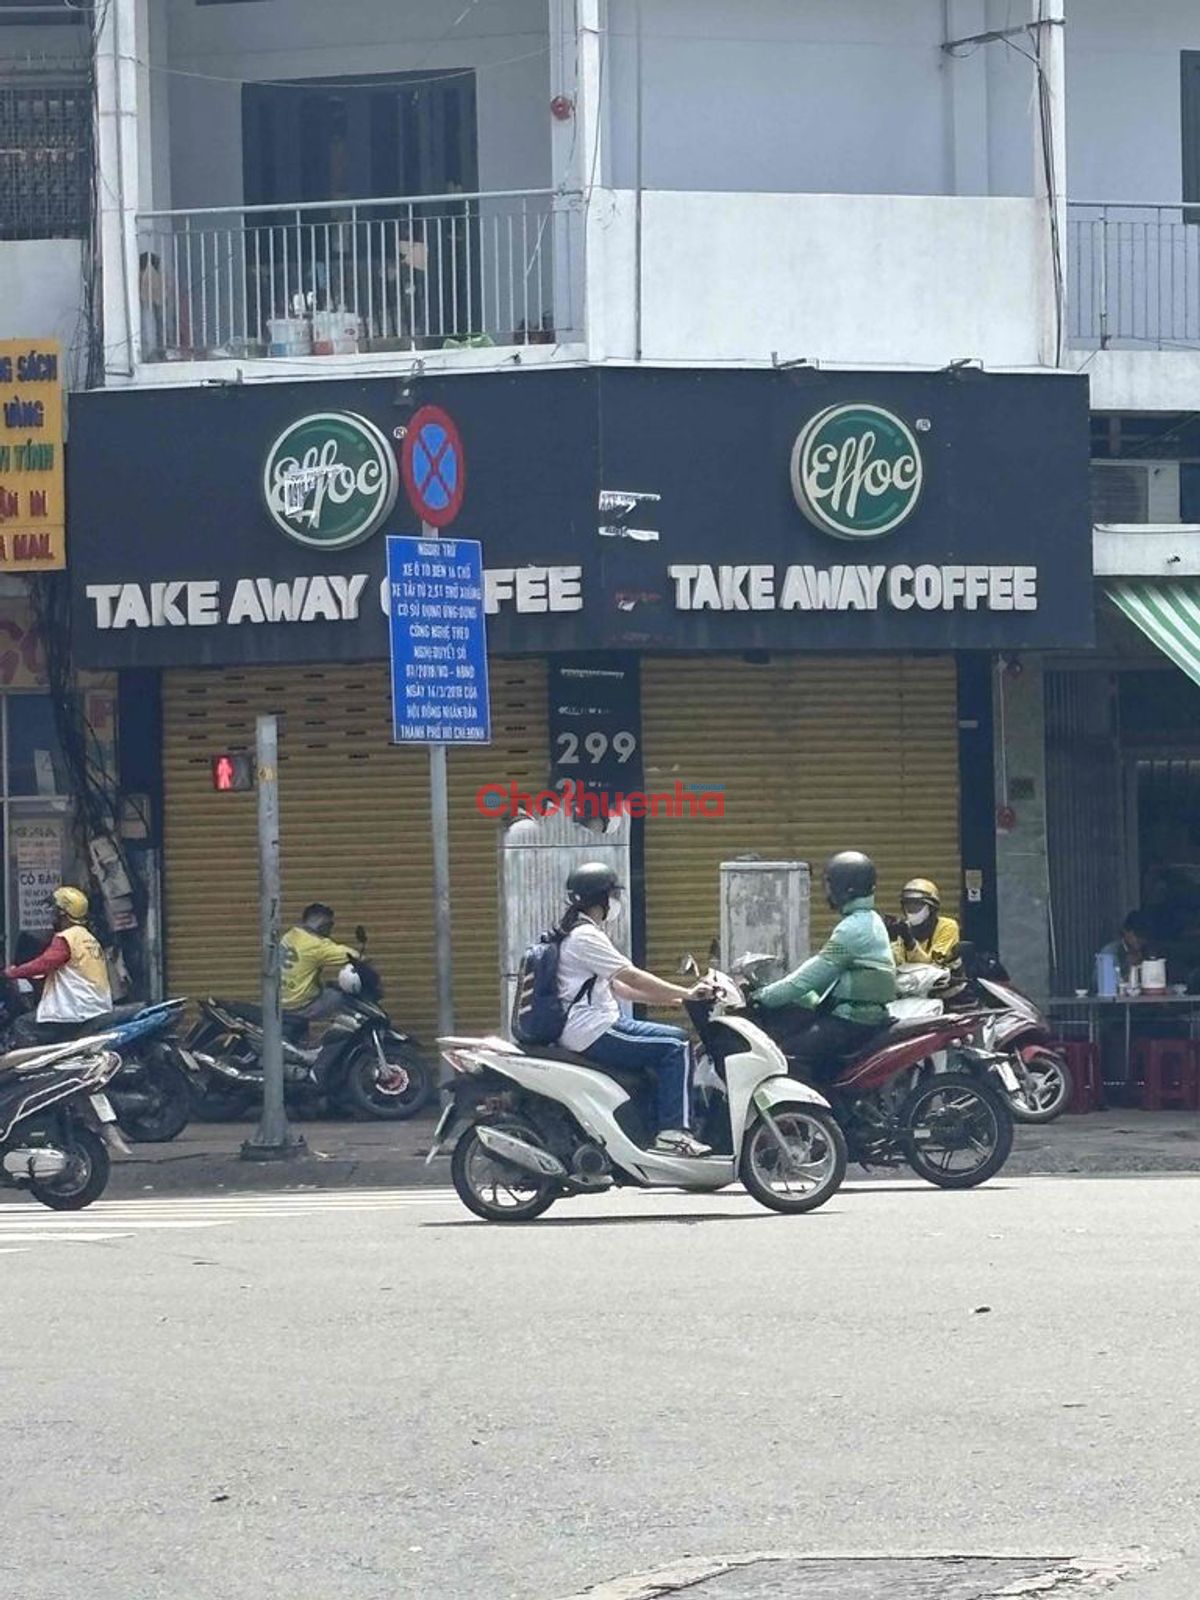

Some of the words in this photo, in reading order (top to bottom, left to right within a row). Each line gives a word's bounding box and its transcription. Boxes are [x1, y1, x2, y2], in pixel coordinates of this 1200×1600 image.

[806, 431, 918, 518] Effoc
[86, 581, 221, 630] TAKE
[227, 573, 368, 623] AWAY
[668, 564, 776, 611] TAKE
[780, 564, 887, 611] AWAY
[888, 564, 1038, 611] COFFEE
[556, 730, 637, 764] 299
